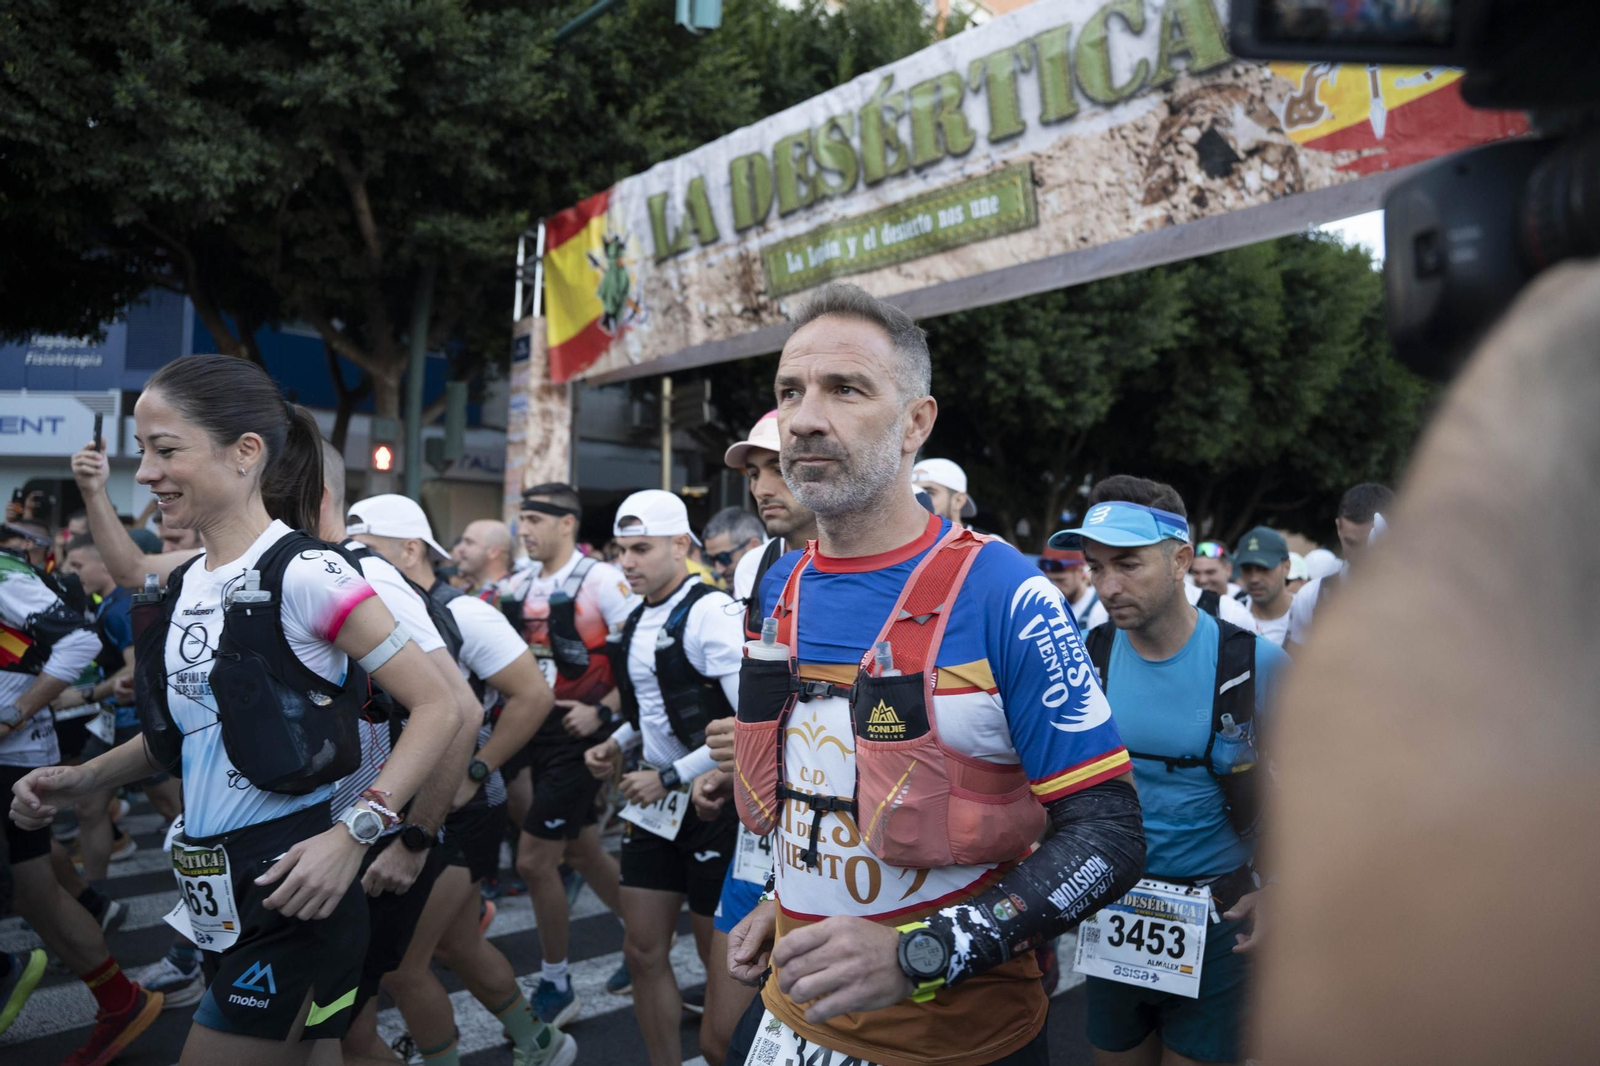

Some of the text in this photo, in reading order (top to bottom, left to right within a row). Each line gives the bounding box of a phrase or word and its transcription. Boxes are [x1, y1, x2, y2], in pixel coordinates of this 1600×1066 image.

[646, 0, 1234, 266] LA DESÉRTICA
[846, 234, 859, 260] y
[863, 226, 878, 251] el
[881, 211, 934, 245] desierto
[938, 203, 965, 229] nos
[969, 193, 1000, 218] une
[1018, 613, 1069, 709] VIENTO
[1058, 640, 1072, 667] DEL
[867, 724, 907, 733] AONIJIE
[800, 766, 829, 788] C.D.
[1123, 894, 1197, 918] DESÉRTICA
[1107, 914, 1186, 960] 3453
[1113, 964, 1150, 982] asisa
[1147, 958, 1180, 972] ALMALEX
[228, 992, 270, 1010] mobel
